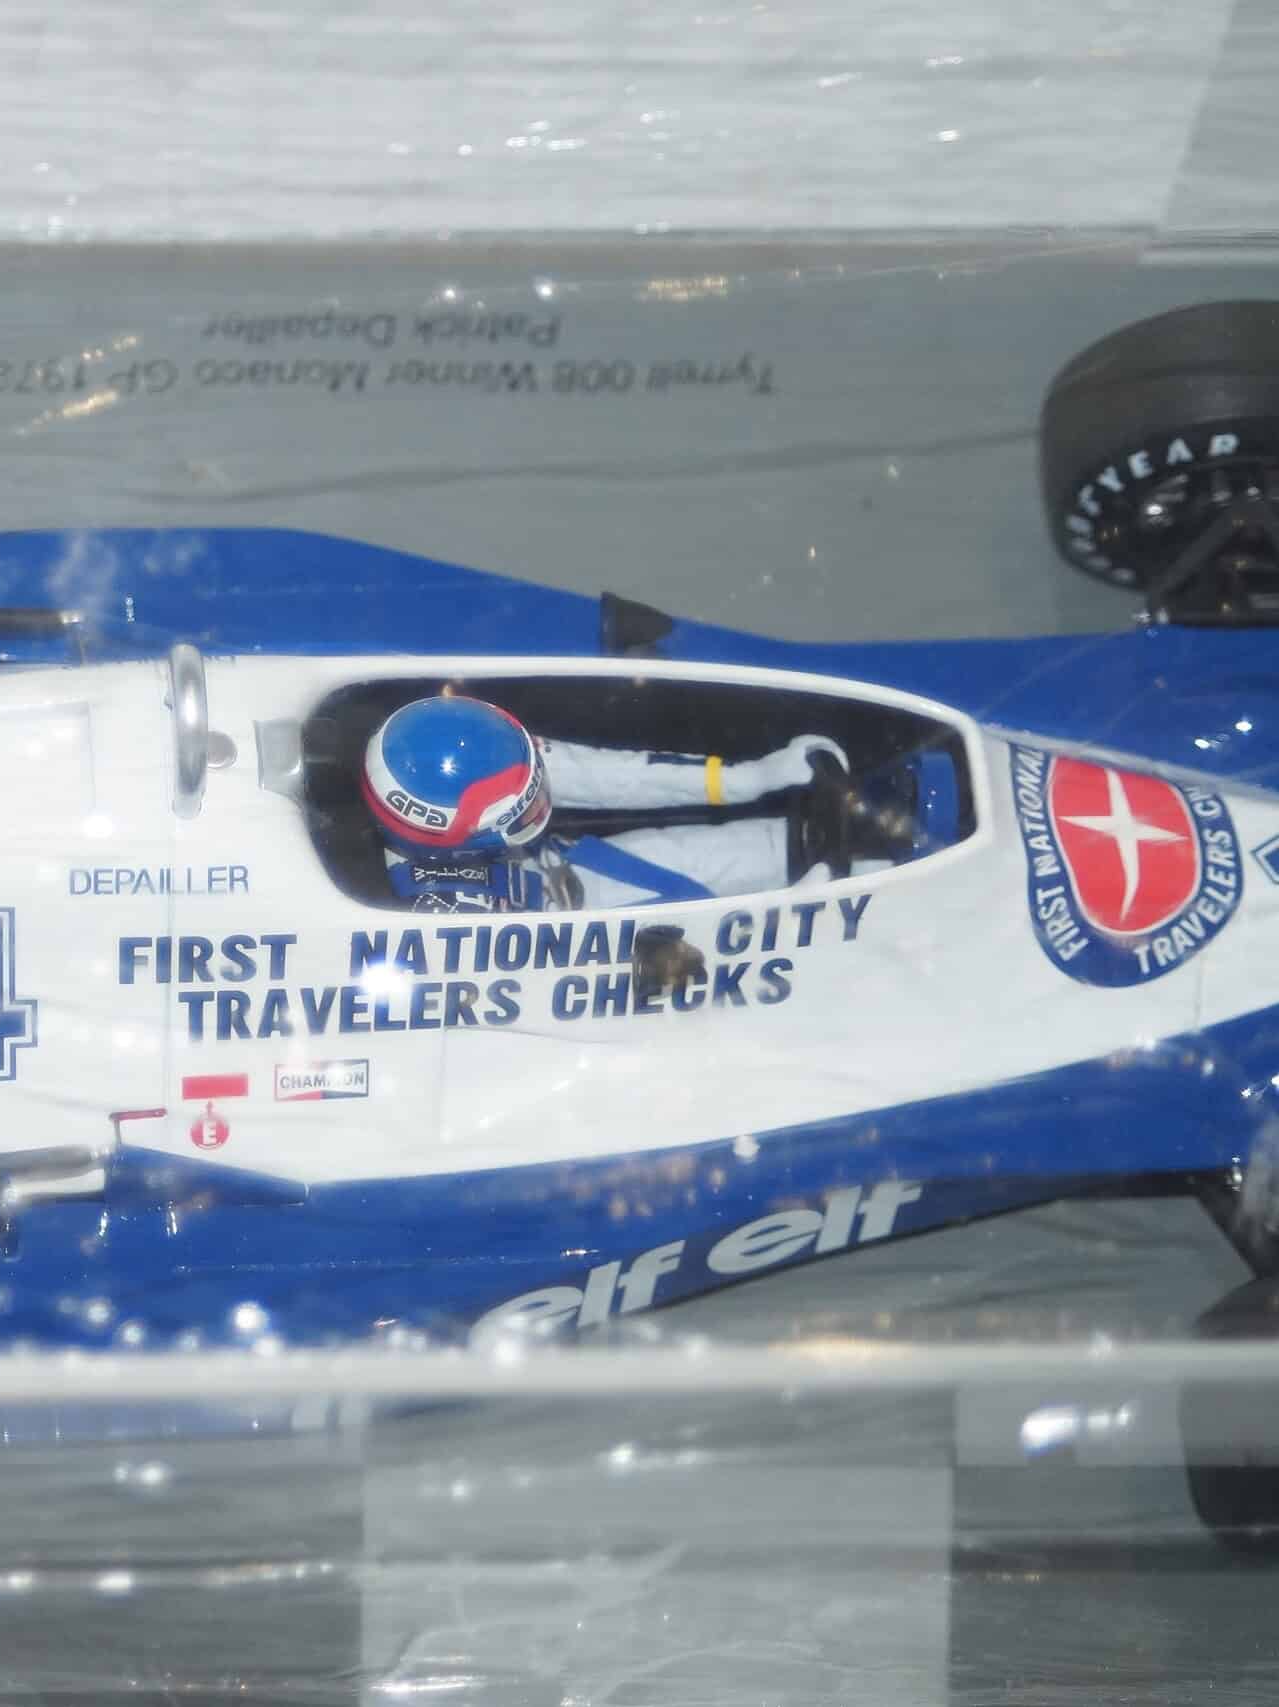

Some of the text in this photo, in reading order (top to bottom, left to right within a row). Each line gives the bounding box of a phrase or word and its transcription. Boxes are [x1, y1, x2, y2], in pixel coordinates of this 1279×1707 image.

[202, 310, 562, 350] Patrick Depailler
[195, 357, 366, 392] Monaco
[385, 356, 537, 393] Winner
[644, 352, 778, 394] Tyrrell
[69, 865, 250, 896] DEPAILLER
[1016, 747, 1089, 961] FIRST NATIONAL
[1135, 829, 1237, 975] TRAVELERS
[119, 934, 298, 985] FIRST
[715, 894, 873, 957] CITY
[177, 978, 521, 1042] TRAVELERS
[468, 1180, 923, 1355] elf elf
